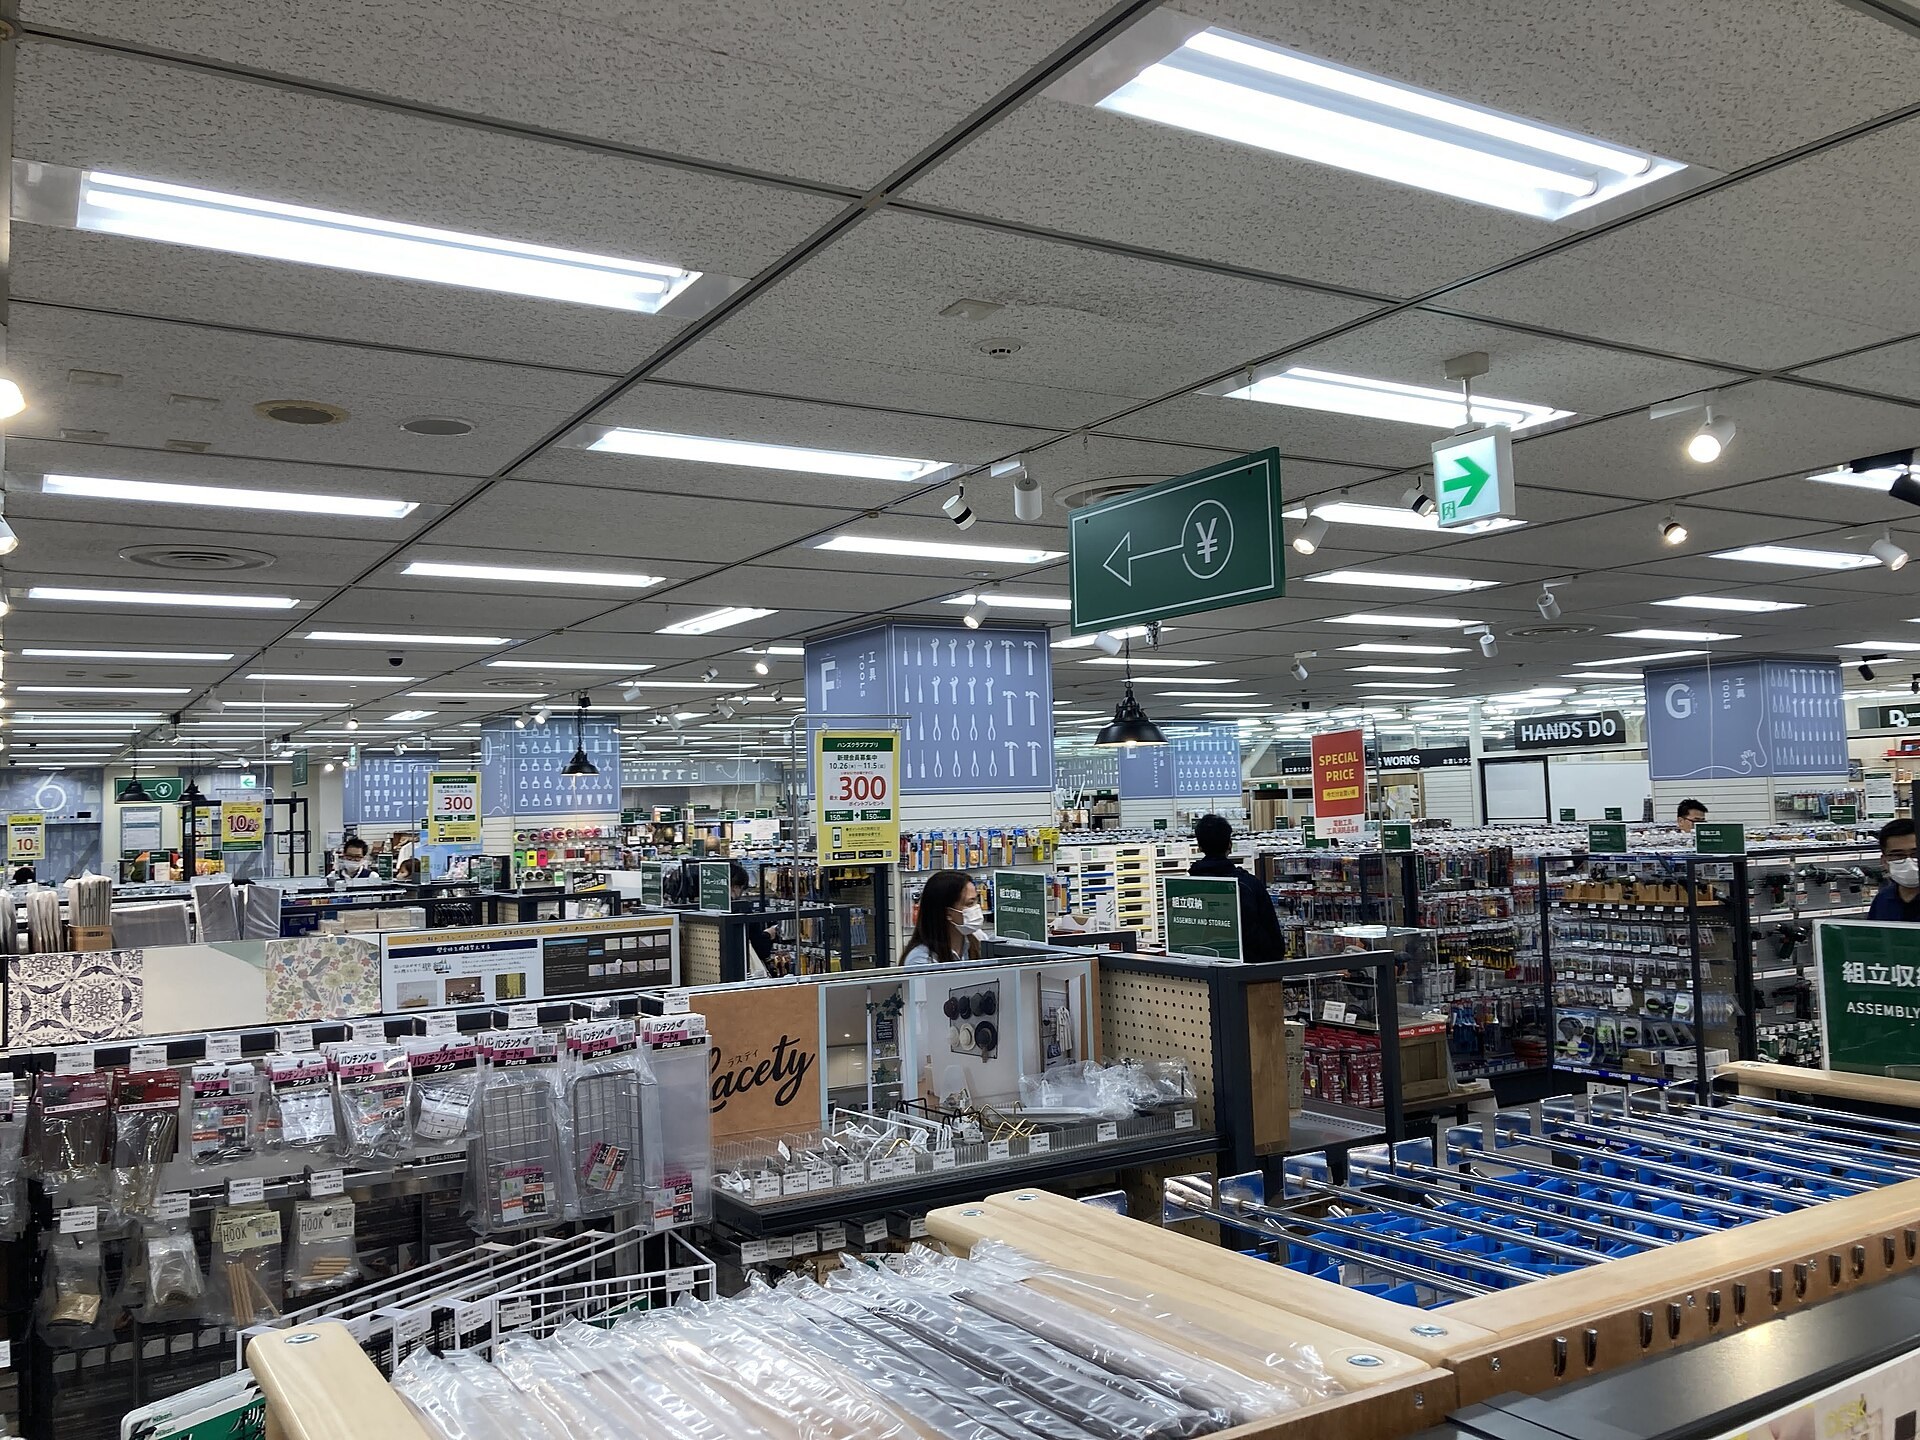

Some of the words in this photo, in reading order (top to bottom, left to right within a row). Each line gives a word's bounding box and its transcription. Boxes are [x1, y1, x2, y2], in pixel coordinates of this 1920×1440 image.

[868, 650, 877, 682] 工具
[821, 660, 836, 712] F
[1736, 676, 1747, 699] 工具
[1665, 683, 1694, 719] G
[1722, 678, 1732, 711] TOOLS
[1521, 720, 1583, 743] HANDS
[1588, 717, 1616, 737] DO
[1319, 751, 1359, 767] SPECIAL
[1383, 754, 1420, 766] WORKS
[1325, 768, 1355, 782] PRICE
[839, 775, 887, 801] 300
[444, 796, 473, 811] 300
[16, 838, 34, 851] 10
[1172, 896, 1203, 910] 組立収納
[1173, 916, 1197, 925] ASSEMBLY
[1197, 918, 1208, 926] AND
[1208, 919, 1231, 928] STORAGE
[1846, 1001, 1920, 1019] ASSEMBLY
[494, 1038, 521, 1049] パンチング
[341, 1052, 370, 1065] パンチング
[412, 1048, 475, 1067] パンチングボード用
[592, 1049, 612, 1058] Parts
[728, 1048, 759, 1068] ラスティ
[434, 1062, 456, 1072] フック
[293, 1078, 312, 1087] フック
[355, 1074, 377, 1083] フック
[203, 1089, 224, 1098] フック
[301, 1216, 324, 1232] HOOK
[223, 1227, 248, 1242] HOOK
